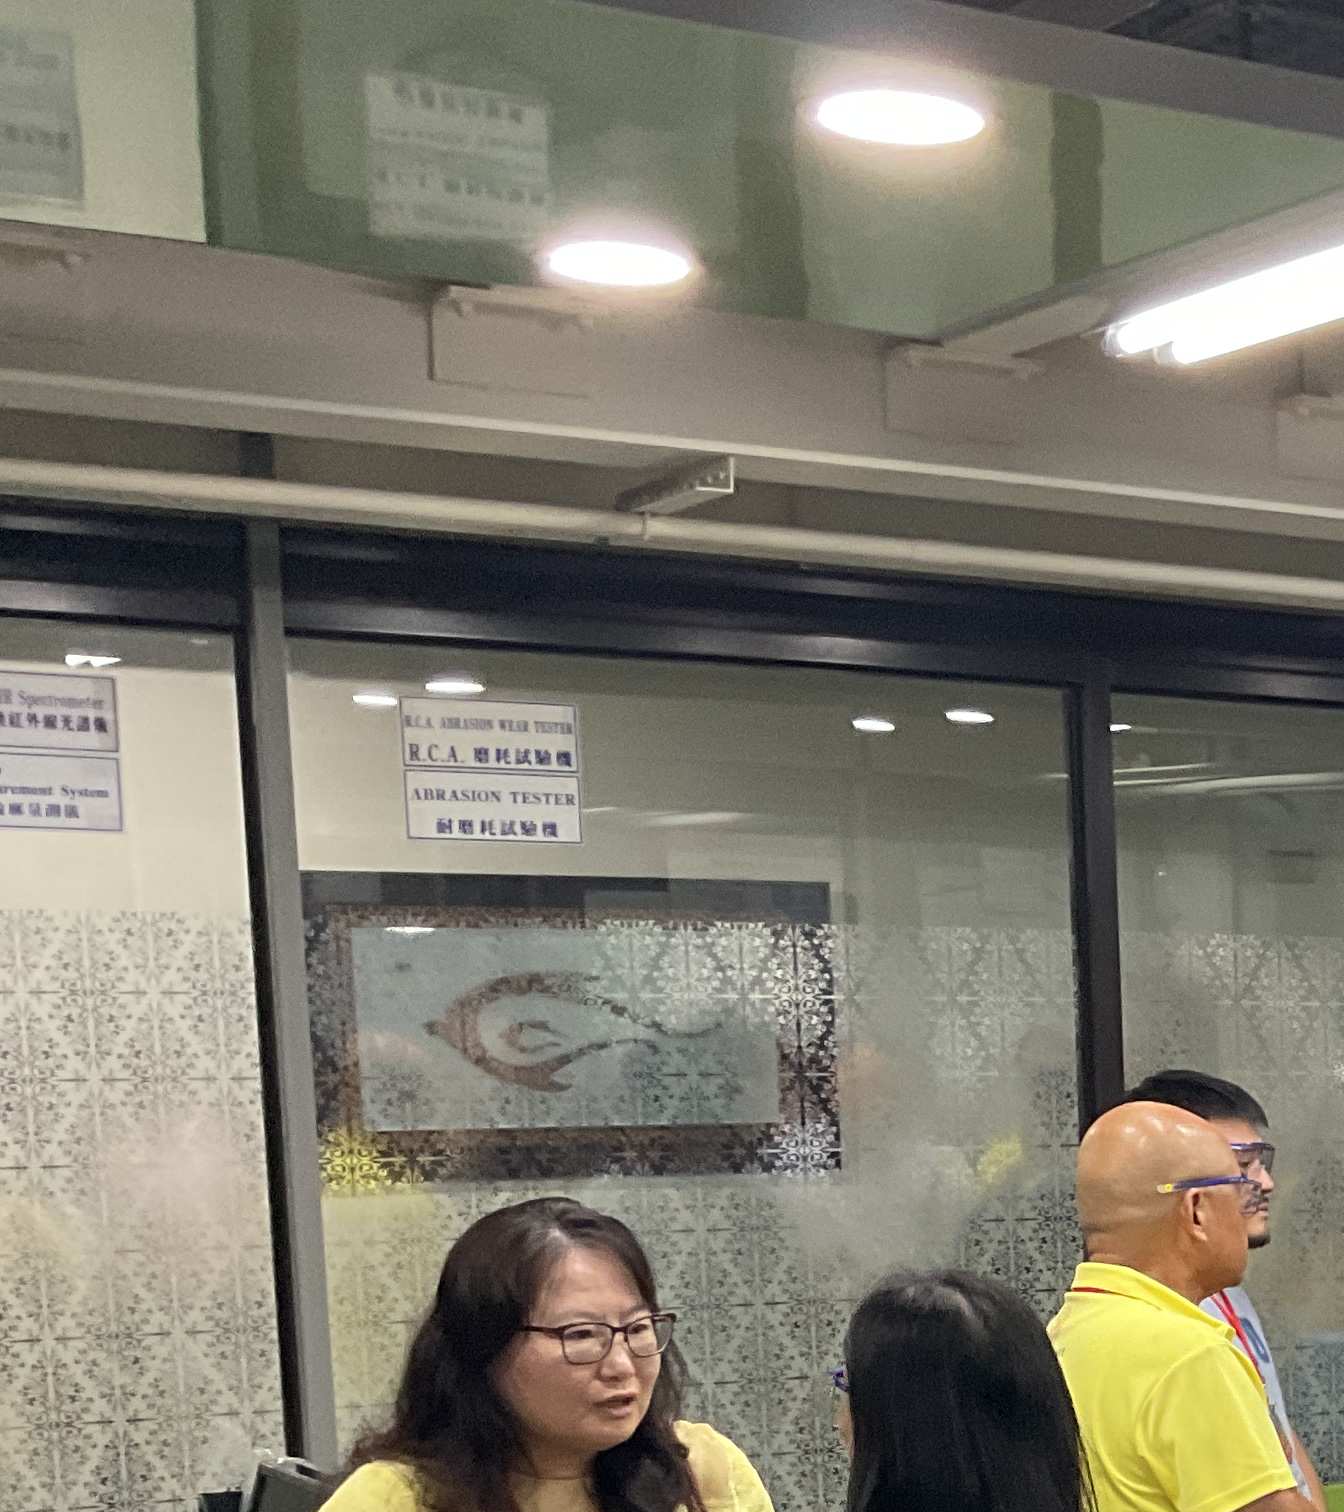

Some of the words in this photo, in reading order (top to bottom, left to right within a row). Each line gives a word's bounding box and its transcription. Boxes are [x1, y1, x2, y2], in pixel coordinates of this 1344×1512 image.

[408, 743, 465, 764] R.C.A.
[412, 788, 503, 804] ABRASION
[509, 791, 577, 807] TESTER
